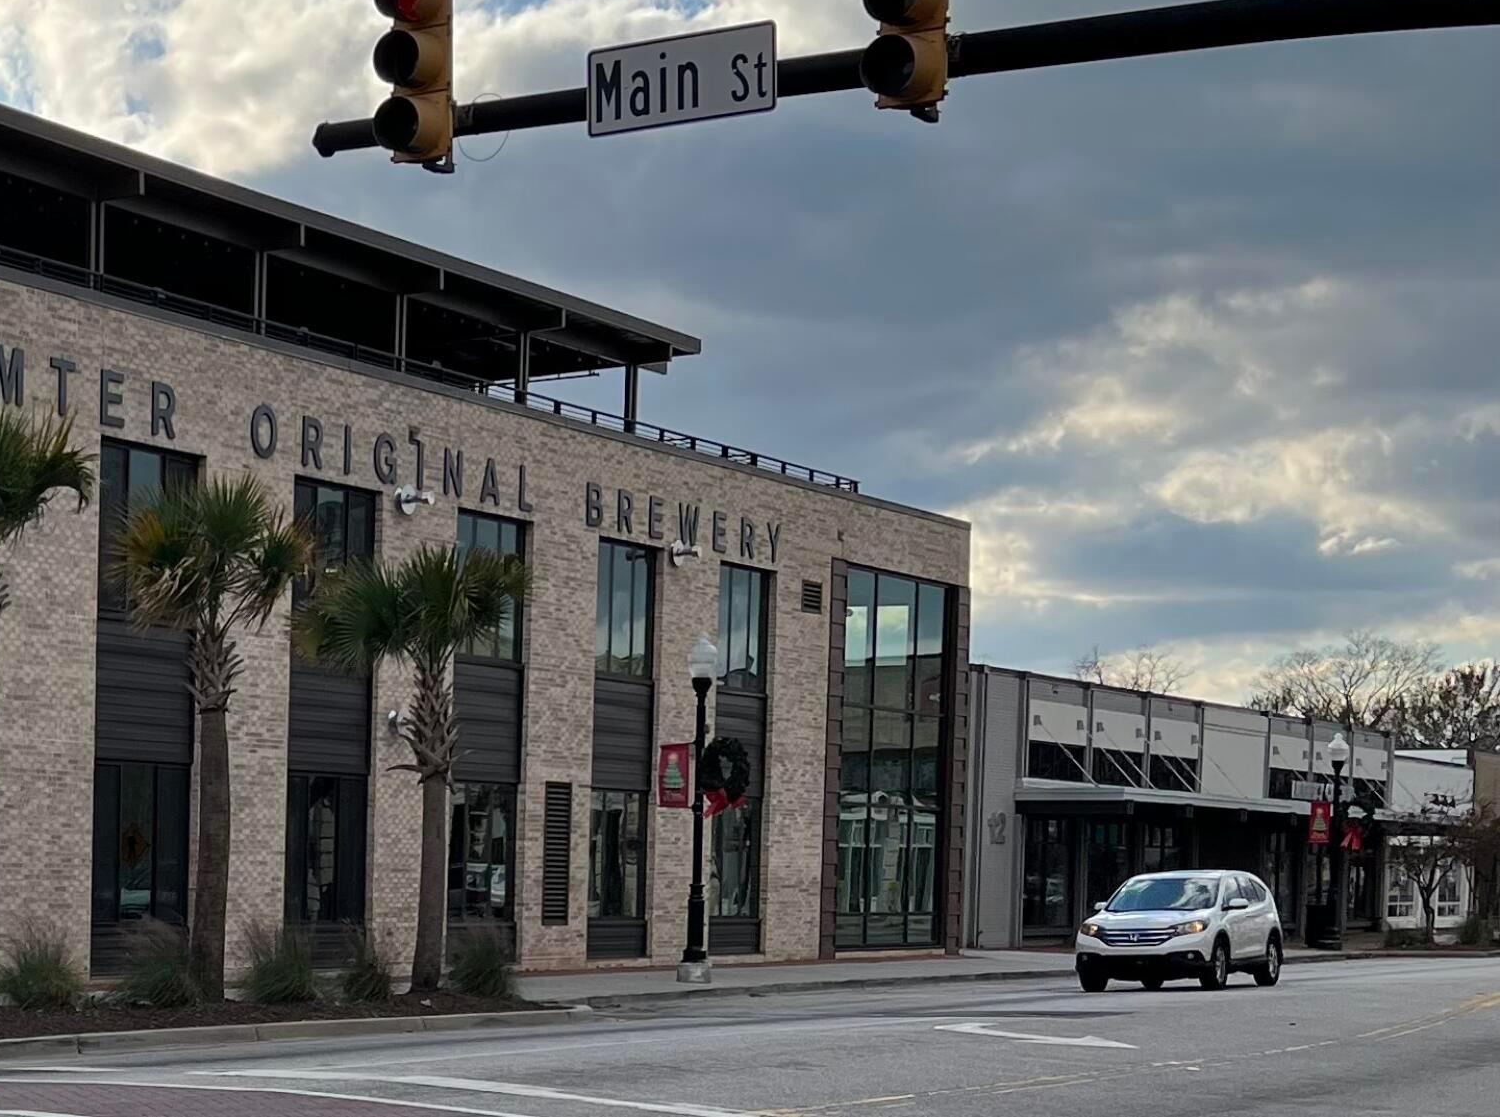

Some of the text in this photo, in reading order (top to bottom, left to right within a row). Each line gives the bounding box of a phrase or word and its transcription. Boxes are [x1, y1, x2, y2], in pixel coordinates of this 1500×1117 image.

[596, 52, 767, 123] Main St
[250, 403, 533, 512] ORIGINAL
[586, 482, 782, 564] BREWERY
